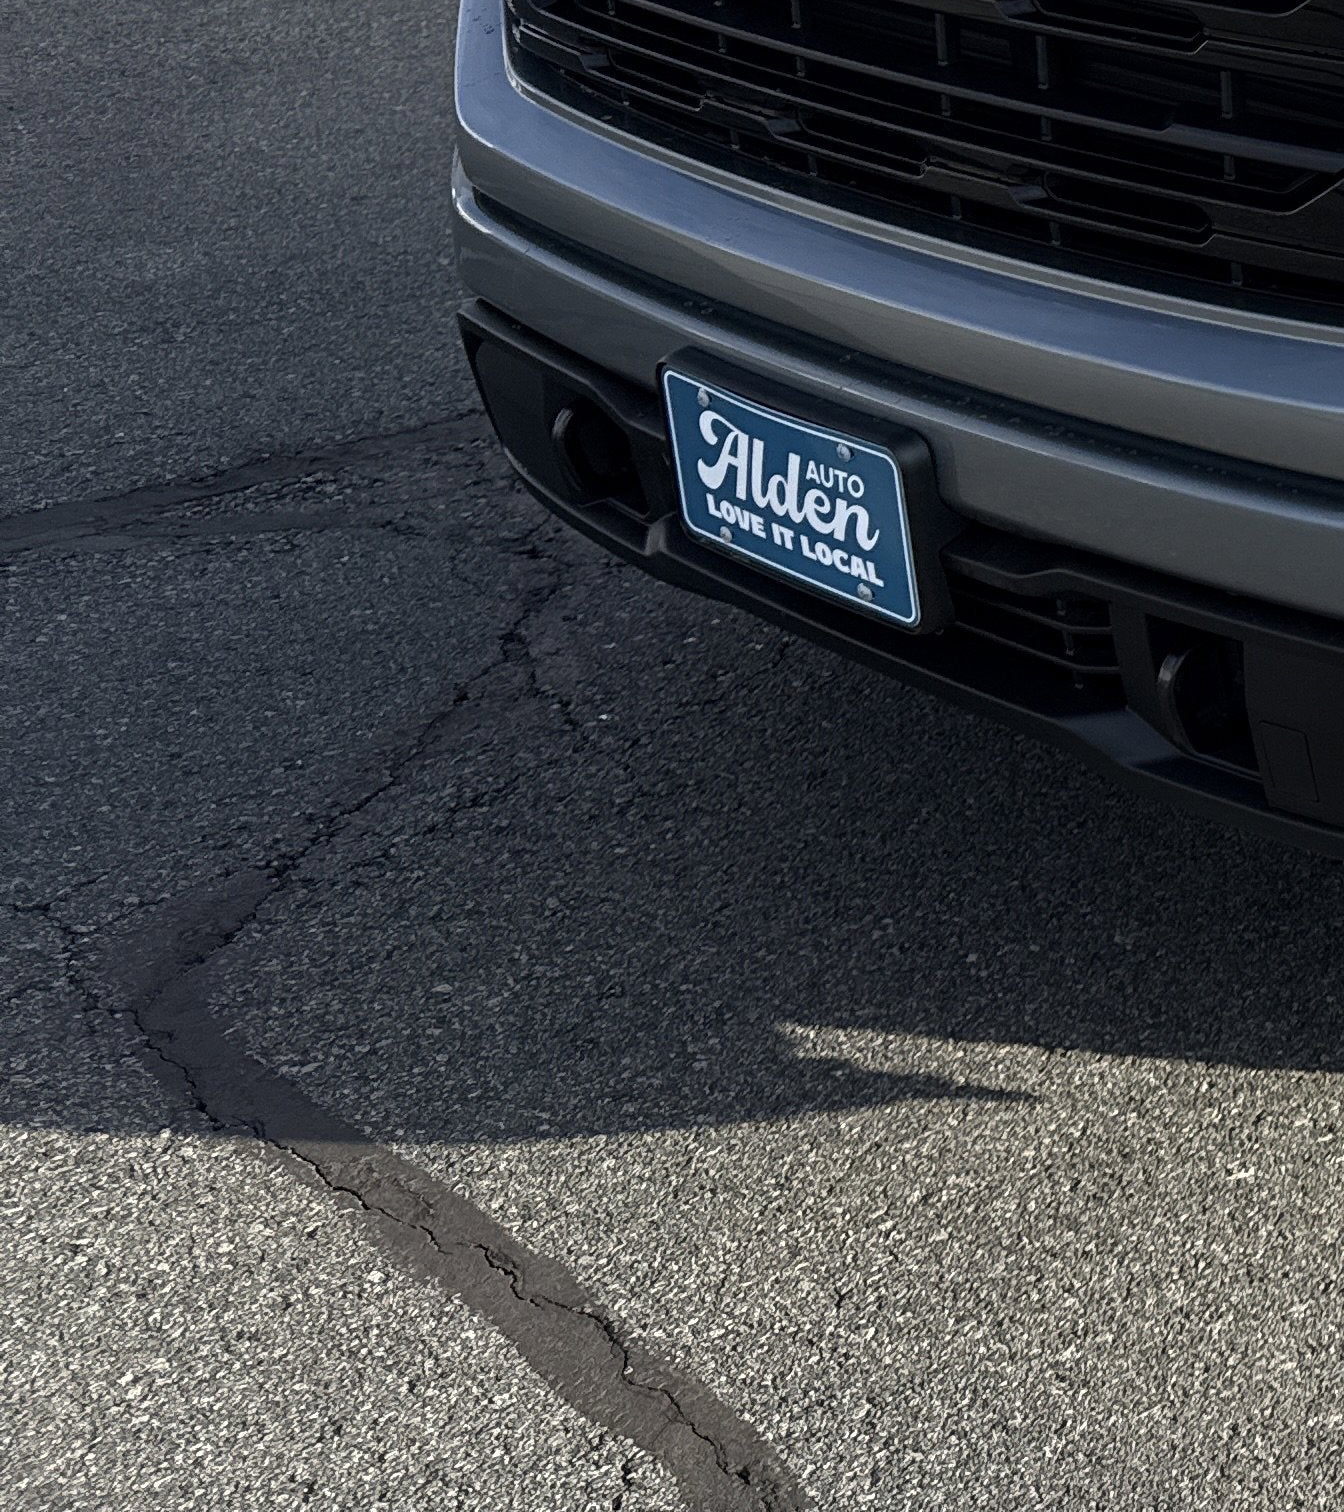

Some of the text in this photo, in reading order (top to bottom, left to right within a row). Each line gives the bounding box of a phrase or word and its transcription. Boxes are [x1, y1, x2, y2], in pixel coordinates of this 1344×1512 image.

[697, 410, 880, 551] Alden
[806, 460, 865, 499] AUTO
[705, 492, 884, 587] LOVE IT LOCAL
